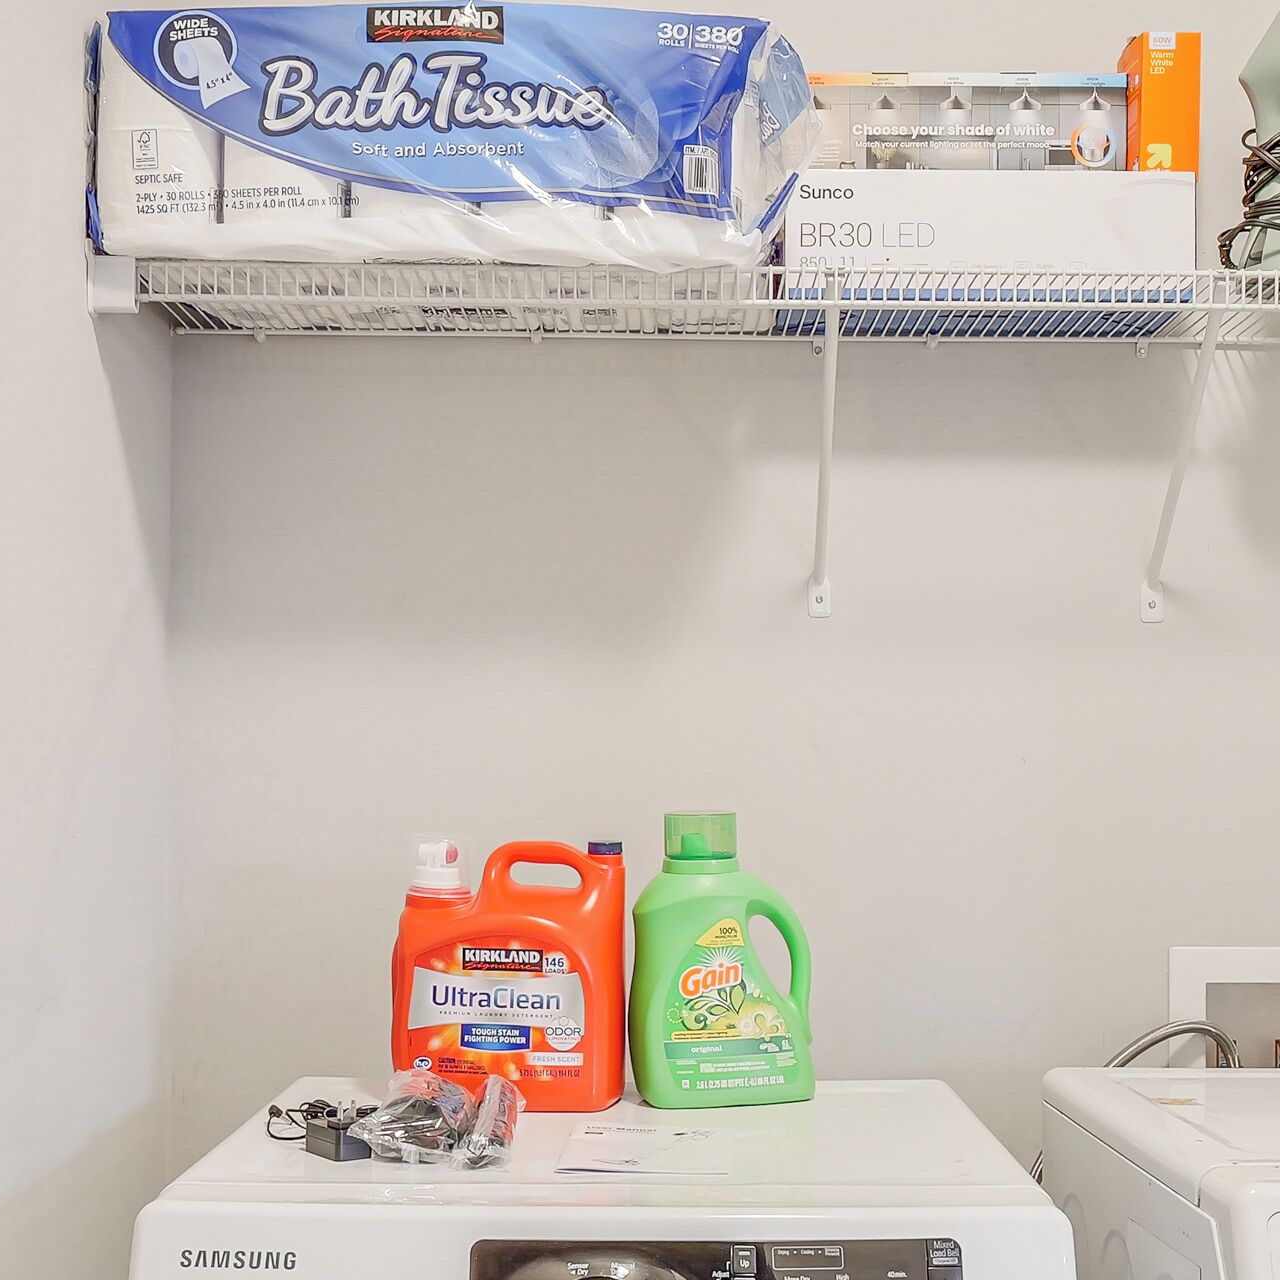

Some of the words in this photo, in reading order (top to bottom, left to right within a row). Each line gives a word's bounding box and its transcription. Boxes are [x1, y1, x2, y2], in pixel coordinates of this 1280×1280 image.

[173, 18, 208, 30] WIDE
[374, 9, 499, 29] KIRKLAND
[169, 27, 218, 41] SHEETS
[374, 25, 499, 42] Signature
[657, 22, 688, 39] 30
[694, 25, 743, 45] 380
[658, 39, 685, 47] ROLLS
[262, 55, 430, 132] Bath
[426, 54, 607, 130] Tissue
[852, 124, 907, 136] Choose
[911, 125, 945, 139] your
[947, 123, 996, 136] shade
[997, 123, 1011, 136] of
[1013, 123, 1055, 136] white
[352, 142, 388, 158] Soft
[394, 142, 427, 158] and
[433, 141, 524, 157] Absorbent
[856, 140, 879, 149] Match
[880, 141, 898, 150] your
[899, 140, 928, 148] current
[930, 139, 959, 150] lighting
[983, 140, 995, 148] the
[997, 139, 1025, 150] perfect
[1027, 140, 1051, 148] mood.
[135, 174, 160, 184] SEPTIC
[163, 173, 182, 183] SAFE
[136, 193, 157, 202] 2-PLY
[166, 192, 176, 201] 30
[179, 191, 204, 200] ROLLS
[231, 188, 261, 197] SHEETS
[264, 187, 279, 196] PER
[281, 186, 302, 195] ROLL
[800, 184, 854, 199] Sunco
[136, 205, 154, 214] 1425
[157, 204, 167, 214] SQ
[170, 203, 179, 213] FT
[182, 202, 205, 213] (132.3
[232, 200, 244, 209] 4.5
[262, 199, 276, 208] 4.0
[800, 222, 872, 247] BR30
[882, 222, 936, 247] LED
[464, 950, 540, 963] KIRKLAND
[545, 957, 565, 967] 146
[679, 962, 741, 997] Gain
[432, 985, 561, 1010] UltraClean
[471, 1028, 496, 1036] TOUGH
[545, 1027, 581, 1036] ODOR
[464, 1035, 498, 1043] FIGHTING
[499, 1036, 526, 1044] POWER
[690, 1044, 723, 1054] original
[934, 1241, 954, 1249] Mixed
[180, 1249, 297, 1270] SAMSUNG
[930, 1249, 946, 1257] Load
[947, 1249, 959, 1257] Bell
[567, 1262, 589, 1270] Sensor
[739, 1259, 750, 1268] Up
